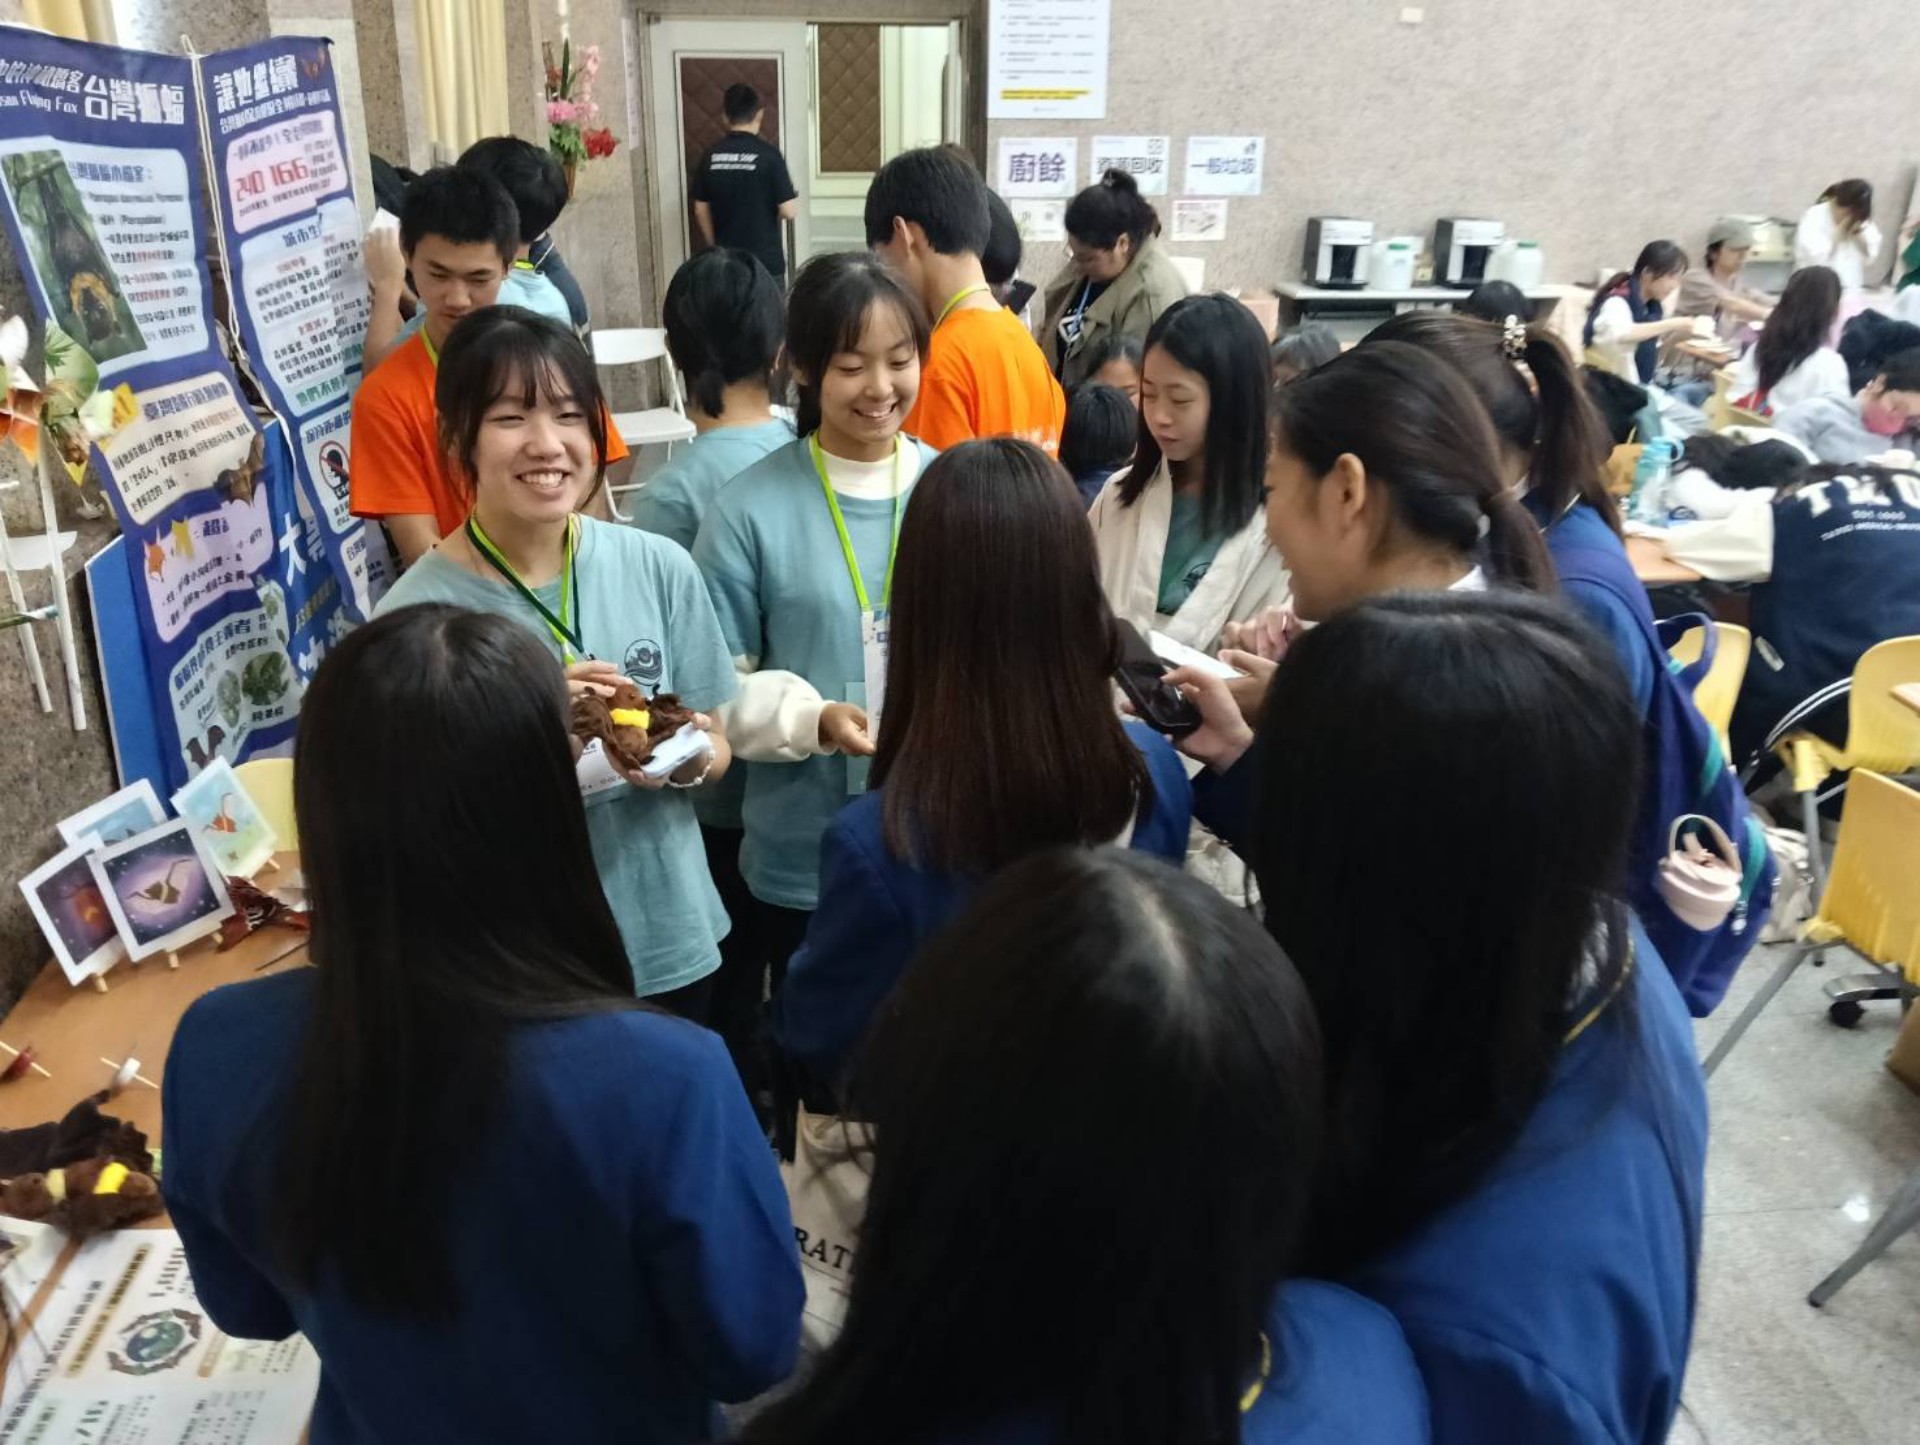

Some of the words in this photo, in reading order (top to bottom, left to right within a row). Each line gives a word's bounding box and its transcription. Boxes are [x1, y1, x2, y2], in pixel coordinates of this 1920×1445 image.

[55, 96, 78, 113] Fox
[269, 157, 309, 187] 166
[1007, 151, 1066, 183] 廚餘
[1189, 157, 1255, 174] 一般垃圾
